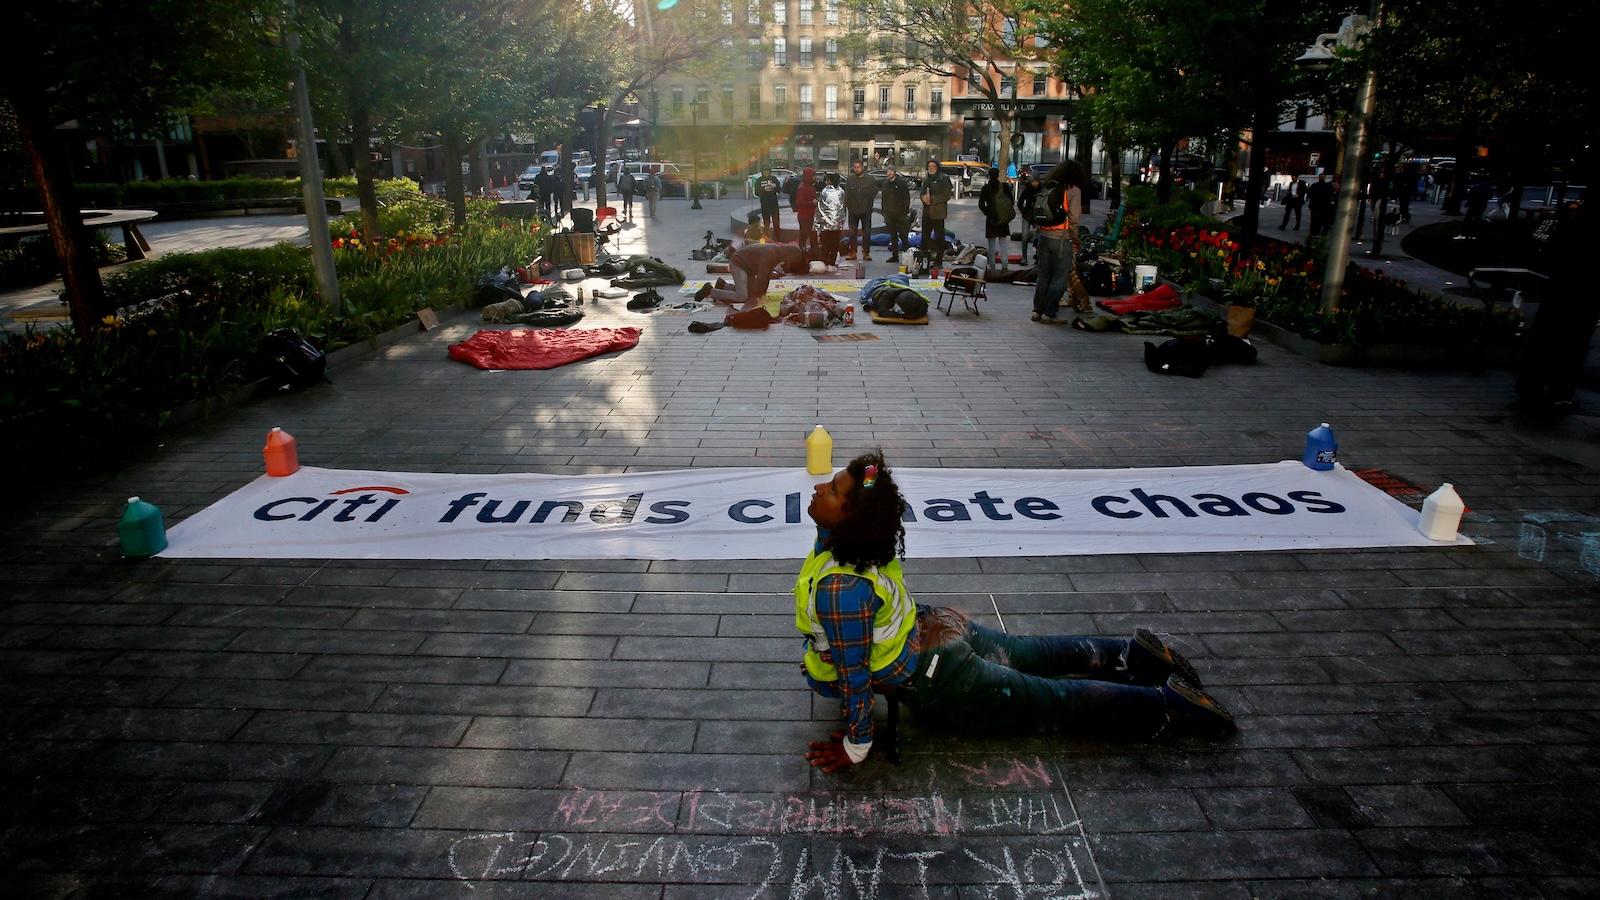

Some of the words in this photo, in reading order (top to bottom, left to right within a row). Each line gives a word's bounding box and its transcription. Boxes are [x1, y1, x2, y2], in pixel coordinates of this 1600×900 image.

[253, 492, 402, 523] citi
[438, 491, 690, 524] funds
[728, 490, 1063, 523] clate
[1091, 487, 1347, 519] chaos
[974, 794, 1081, 833] THAT
[447, 831, 782, 900] CONVINCED
